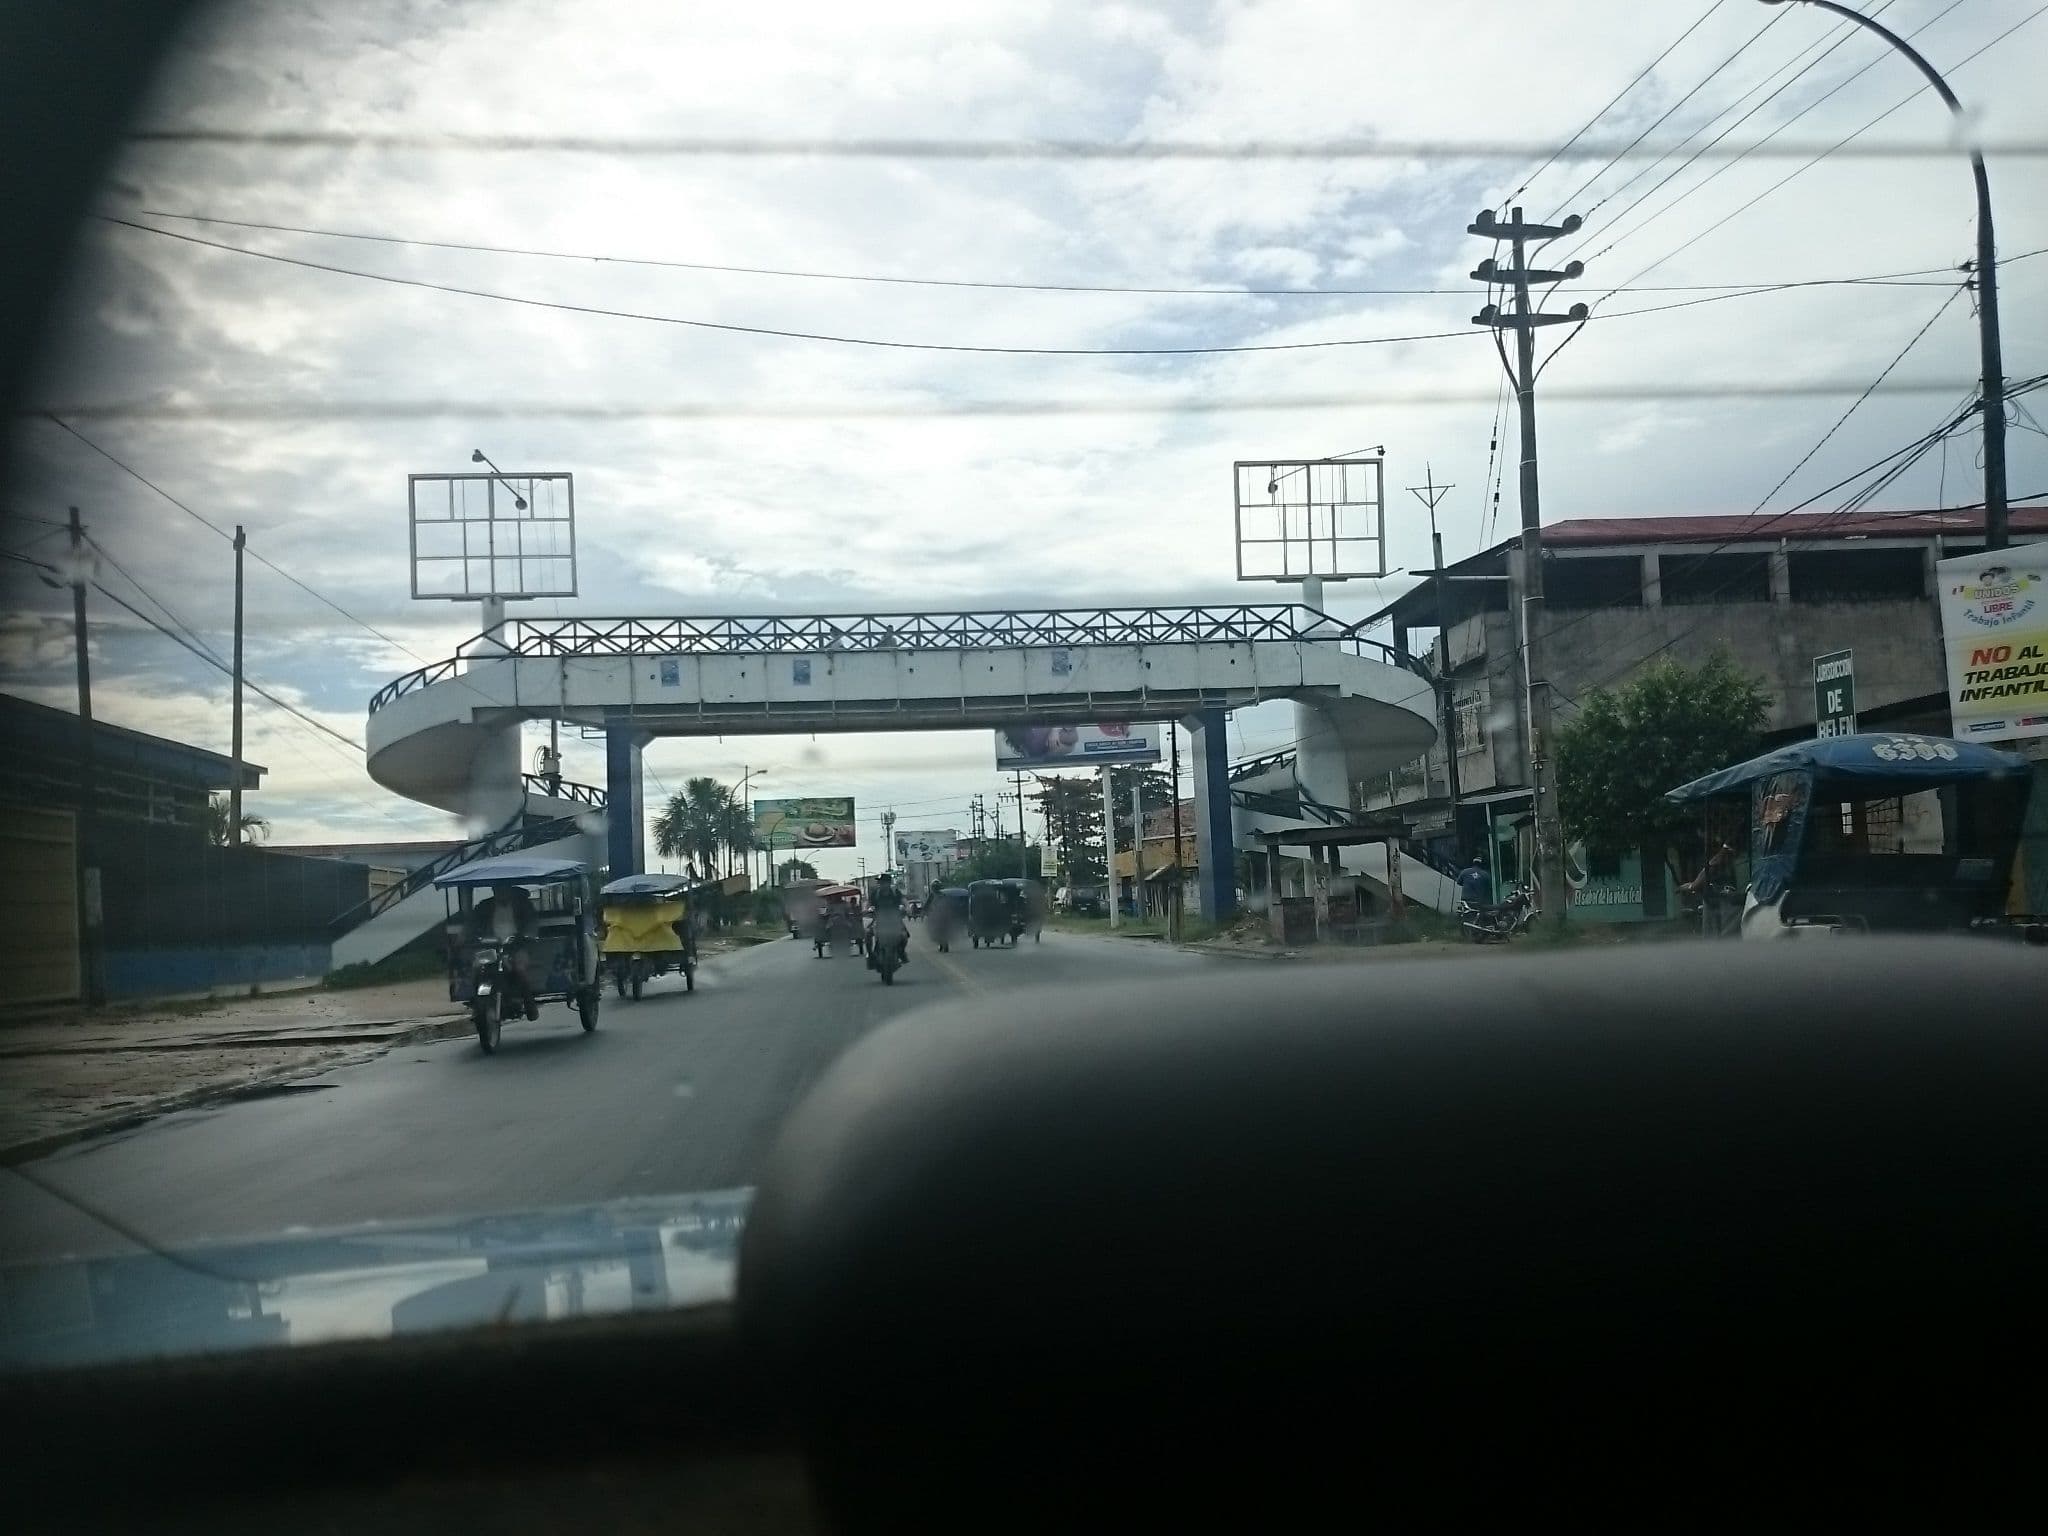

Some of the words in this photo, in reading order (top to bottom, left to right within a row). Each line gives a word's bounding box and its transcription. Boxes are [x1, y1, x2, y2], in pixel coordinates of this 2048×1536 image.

[1963, 608, 2000, 629] Trabajo
[1983, 602, 2014, 614] LIBRE
[1971, 645, 2012, 667] NO
[2018, 645, 2044, 660] AL
[1827, 688, 1843, 714] DE
[1959, 679, 2048, 703] INFANTIL
